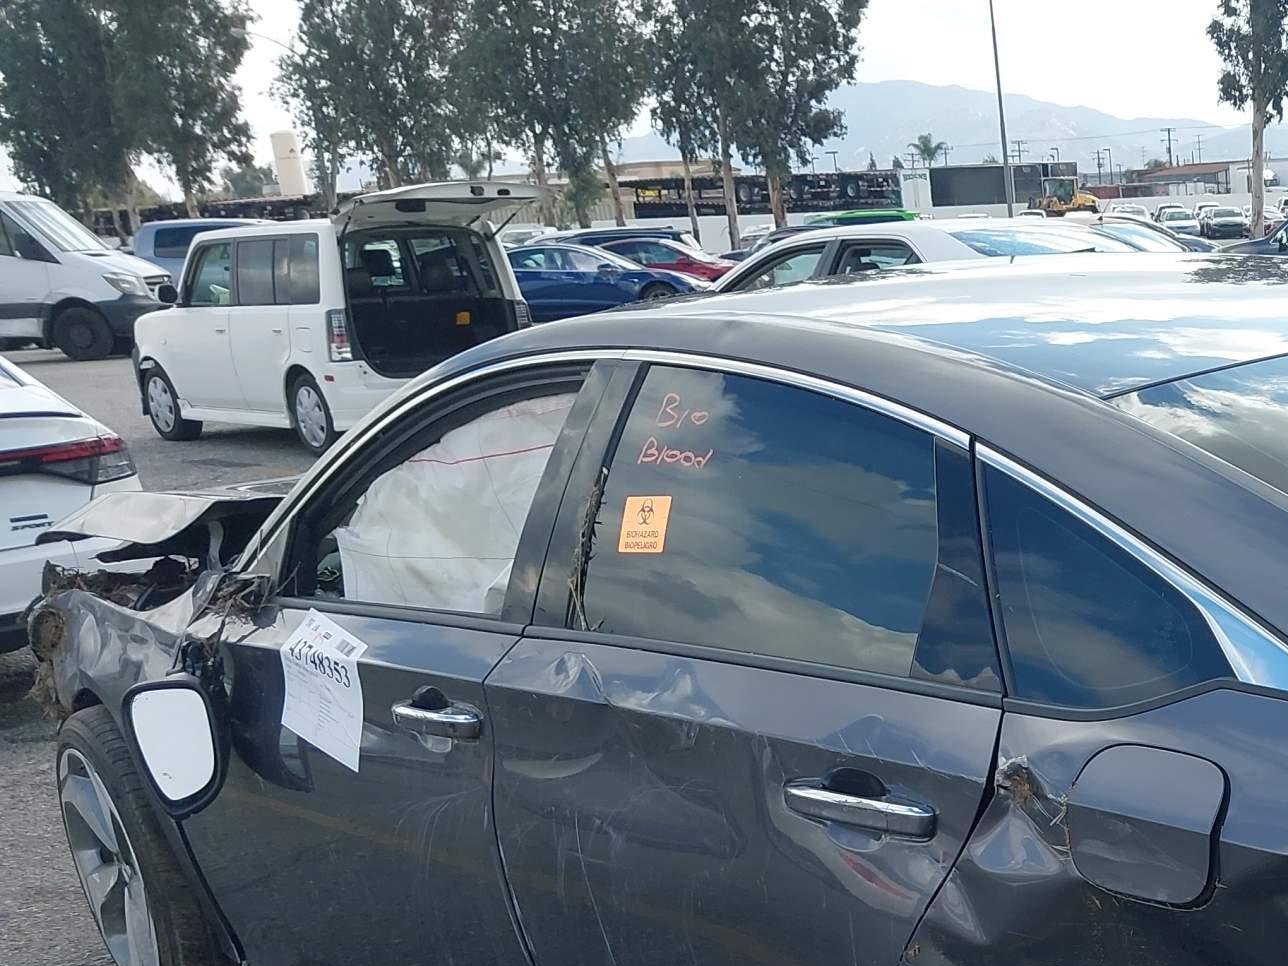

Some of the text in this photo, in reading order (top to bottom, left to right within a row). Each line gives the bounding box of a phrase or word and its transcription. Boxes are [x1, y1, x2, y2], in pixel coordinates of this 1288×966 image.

[626, 530, 659, 538] BIOHAZARD
[624, 541, 658, 550] BIOPELIGRO
[289, 638, 351, 688] 43748353
